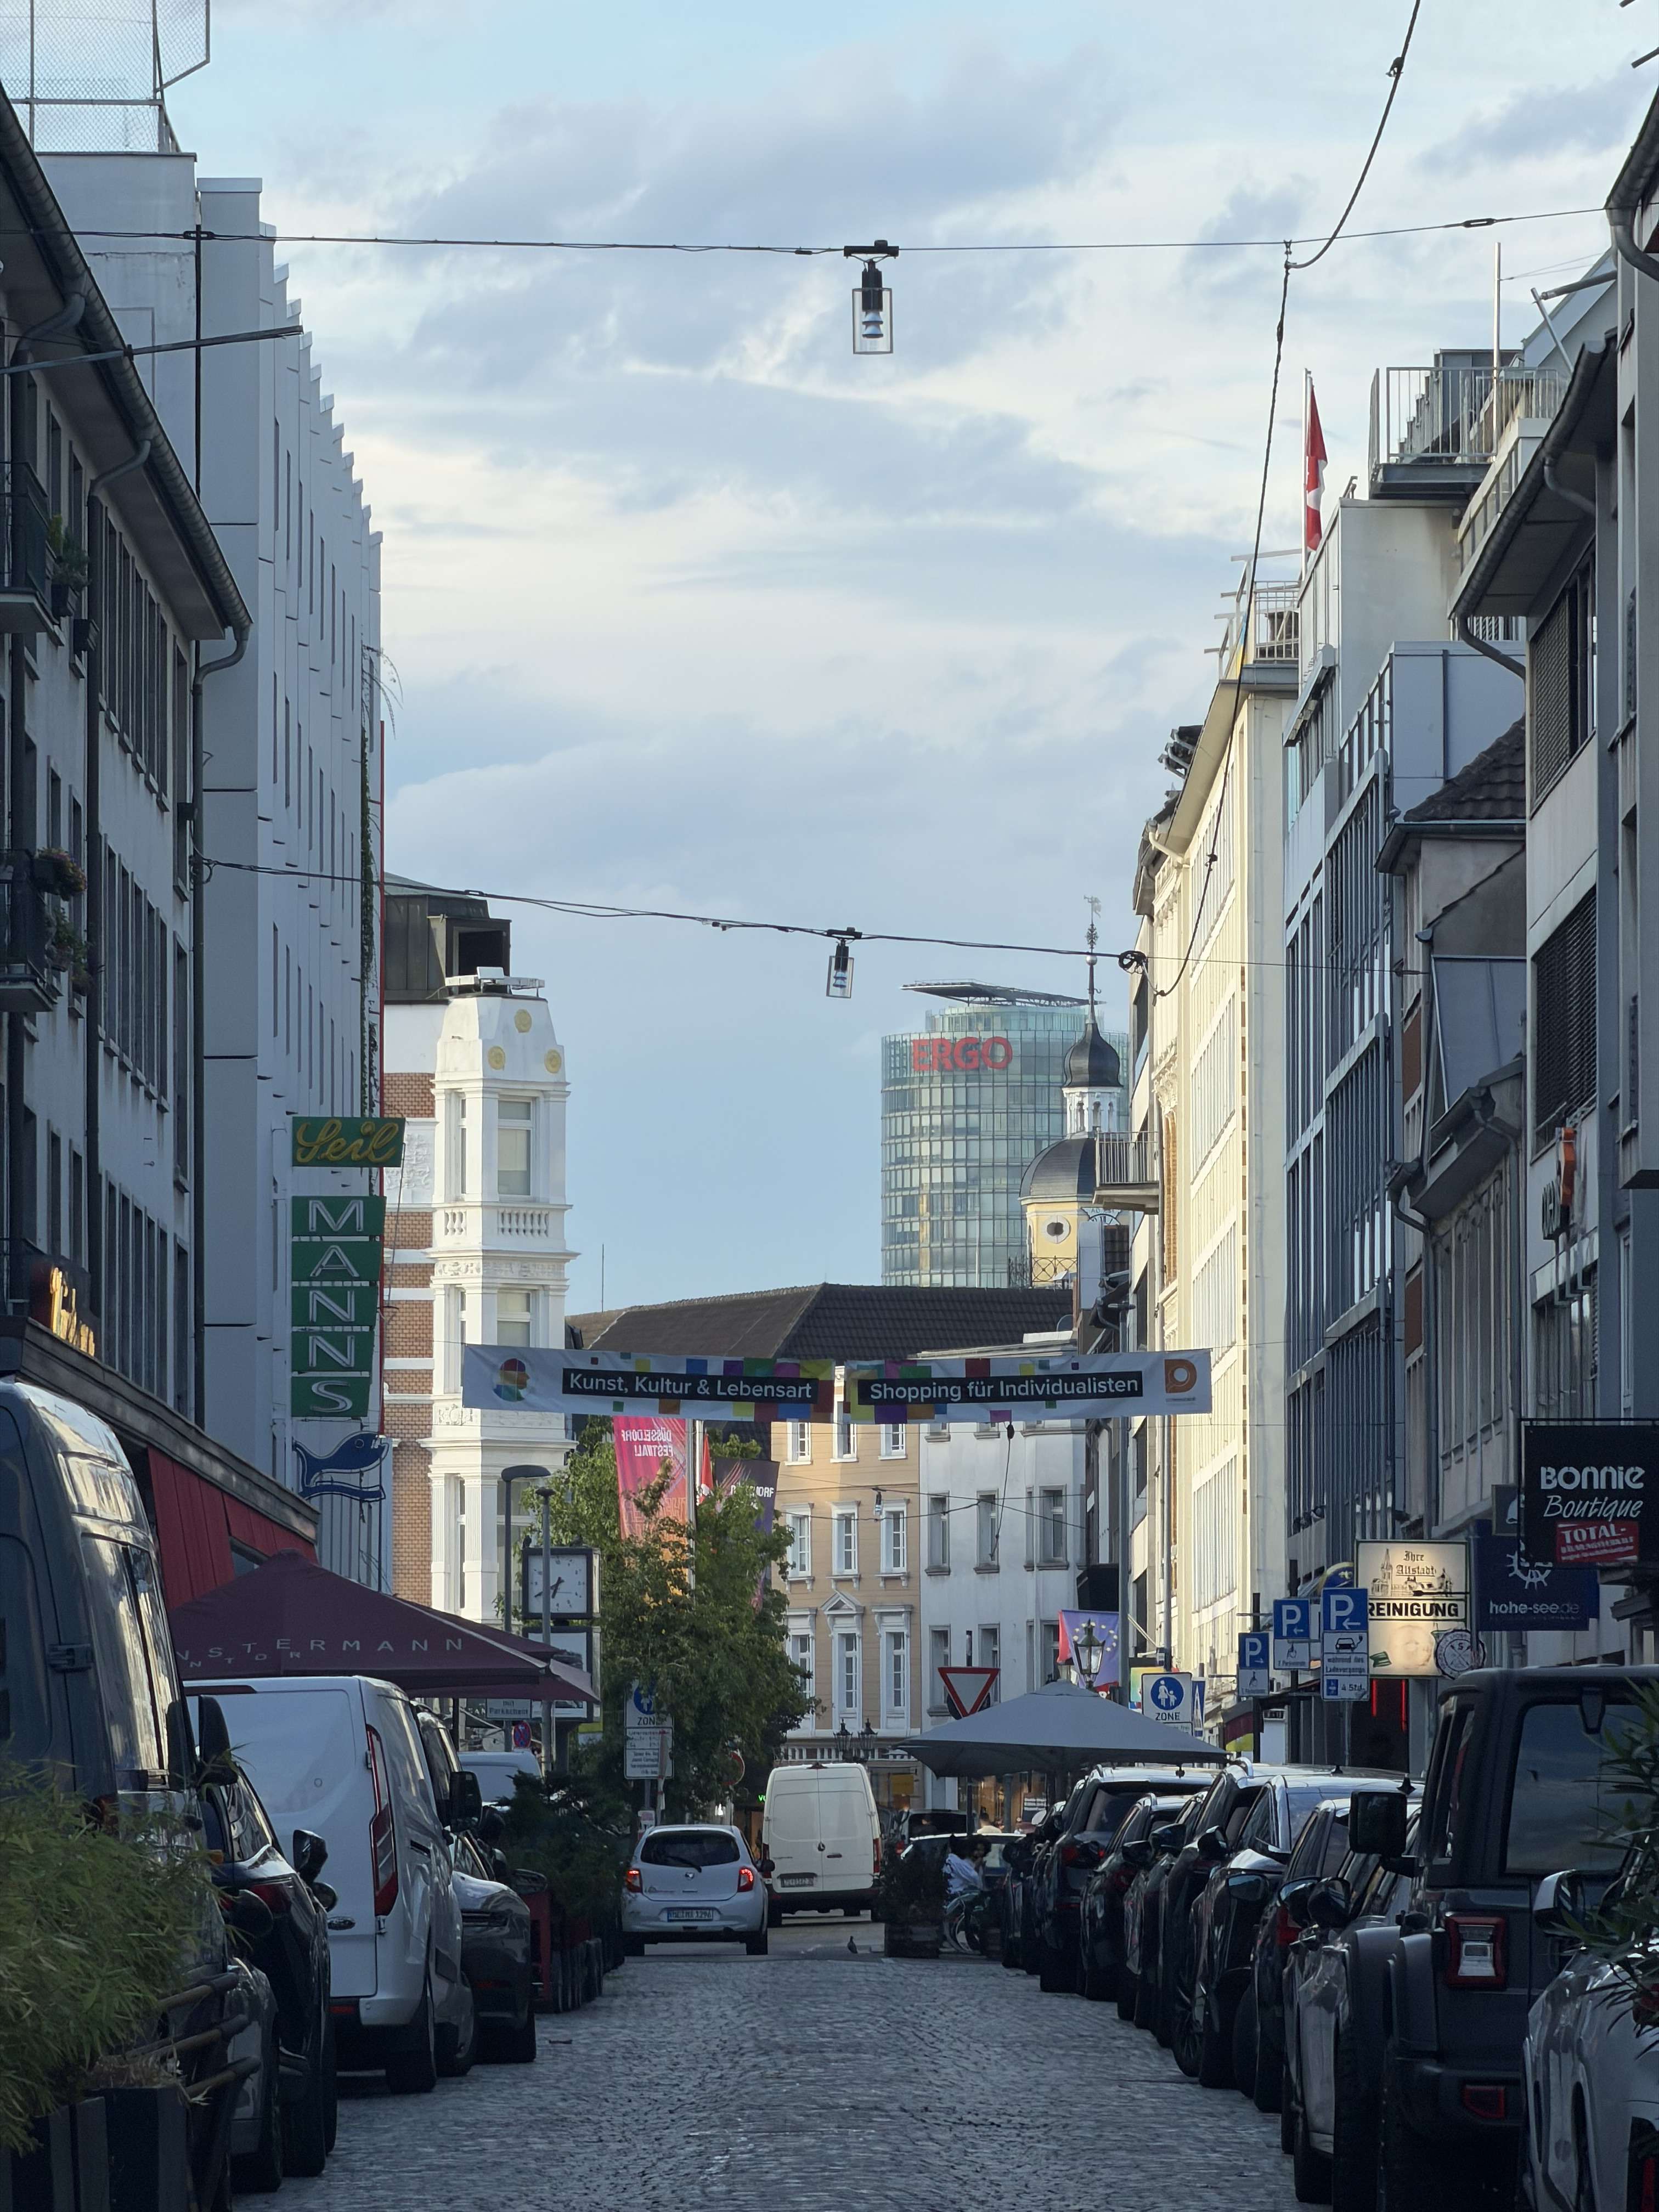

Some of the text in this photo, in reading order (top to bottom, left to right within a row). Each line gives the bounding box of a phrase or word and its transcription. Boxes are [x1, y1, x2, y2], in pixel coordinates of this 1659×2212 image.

[912, 1036, 1013, 1071] ERGO
[308, 1199, 365, 1413] MANNS
[570, 1373, 812, 1398] Kunst, Kultur & Lebensart
[870, 1376, 1138, 1403] Shopping für Individualisten
[1543, 1495, 1644, 1522] Boutique
[1561, 1523, 1627, 1544] TOTAL-
[1403, 1550, 1424, 1562] Ihre
[1282, 1605, 1302, 1637] P
[1330, 1595, 1354, 1630] P
[1369, 1602, 1459, 1617] REINIGUNG
[1245, 1638, 1262, 1667] P
[637, 1717, 658, 1726] ZON
[1155, 1712, 1180, 1721] ZONE
